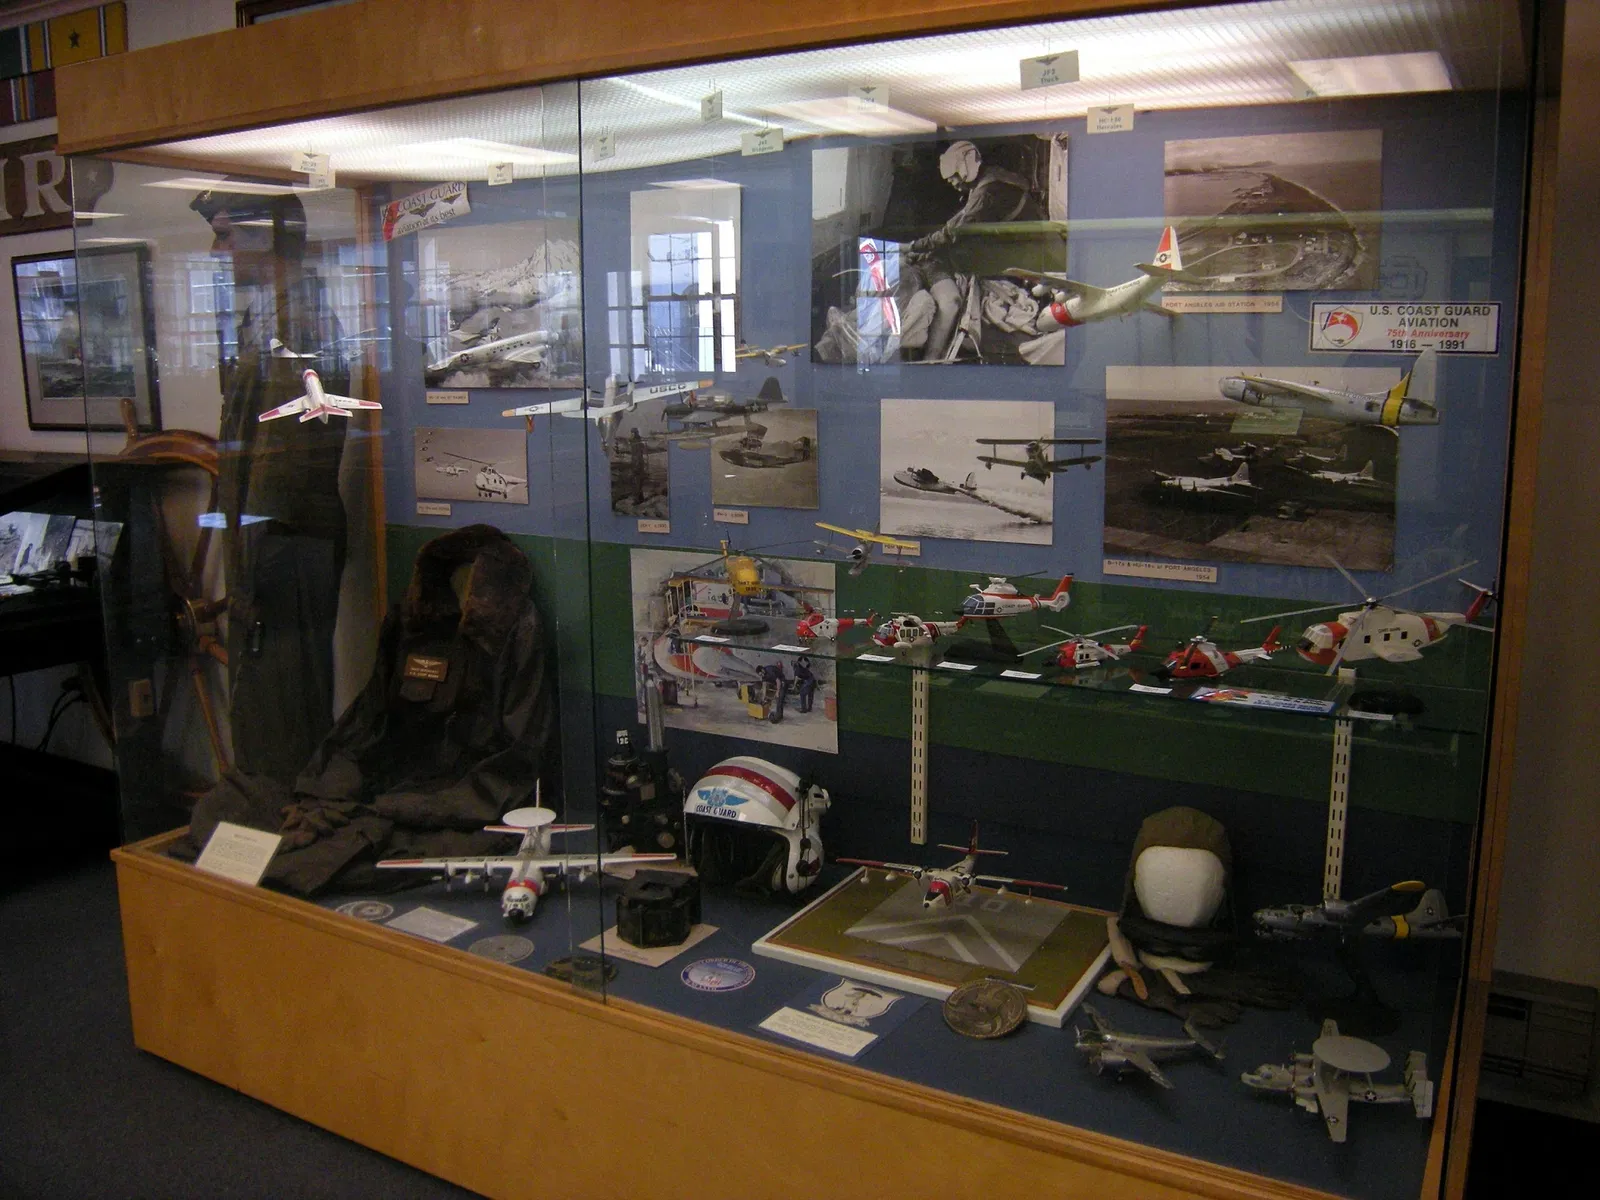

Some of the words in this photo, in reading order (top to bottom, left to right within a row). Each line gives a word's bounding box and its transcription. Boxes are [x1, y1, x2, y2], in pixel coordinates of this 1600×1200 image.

[429, 181, 466, 201] GUARD
[1369, 305, 1393, 316] U.S.
[1397, 305, 1440, 316] COAST
[1444, 305, 1491, 316] GUARD
[1398, 317, 1459, 328] AVIATION
[1386, 328, 1406, 337] 75th
[1410, 328, 1470, 340] Anniversary
[1390, 339, 1417, 349] 1916
[1438, 340, 1465, 350] 1991
[696, 804, 712, 815] COAST
